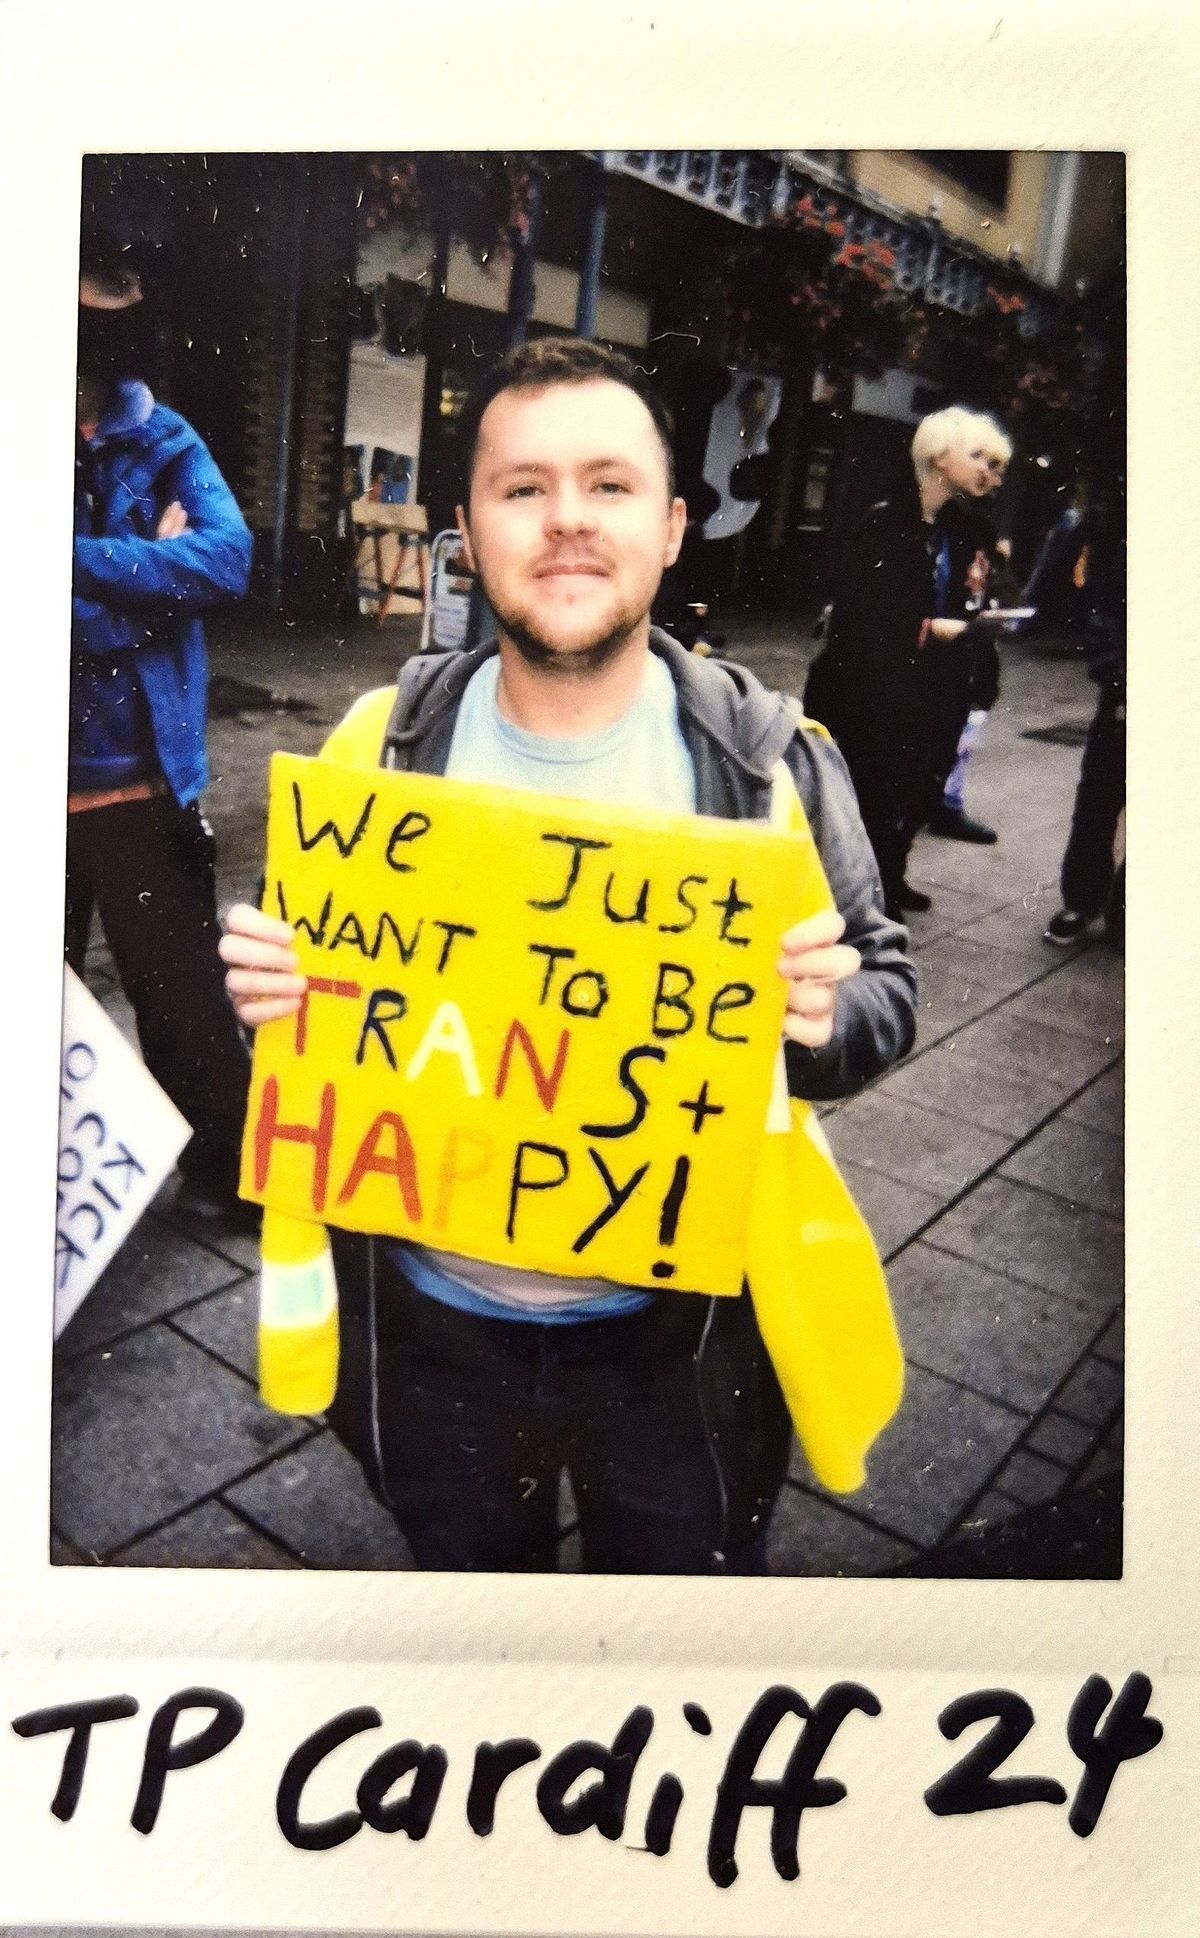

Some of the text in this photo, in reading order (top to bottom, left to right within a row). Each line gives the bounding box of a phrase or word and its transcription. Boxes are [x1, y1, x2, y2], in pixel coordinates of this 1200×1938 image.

[291, 780, 753, 948] We Just
[277, 880, 477, 975] WANT
[652, 962, 756, 1044] Be
[57, 1111, 106, 1211] CO
[254, 1074, 691, 1279] HAPPY!
[11, 1670, 1165, 1889] TP Cardiff 24
